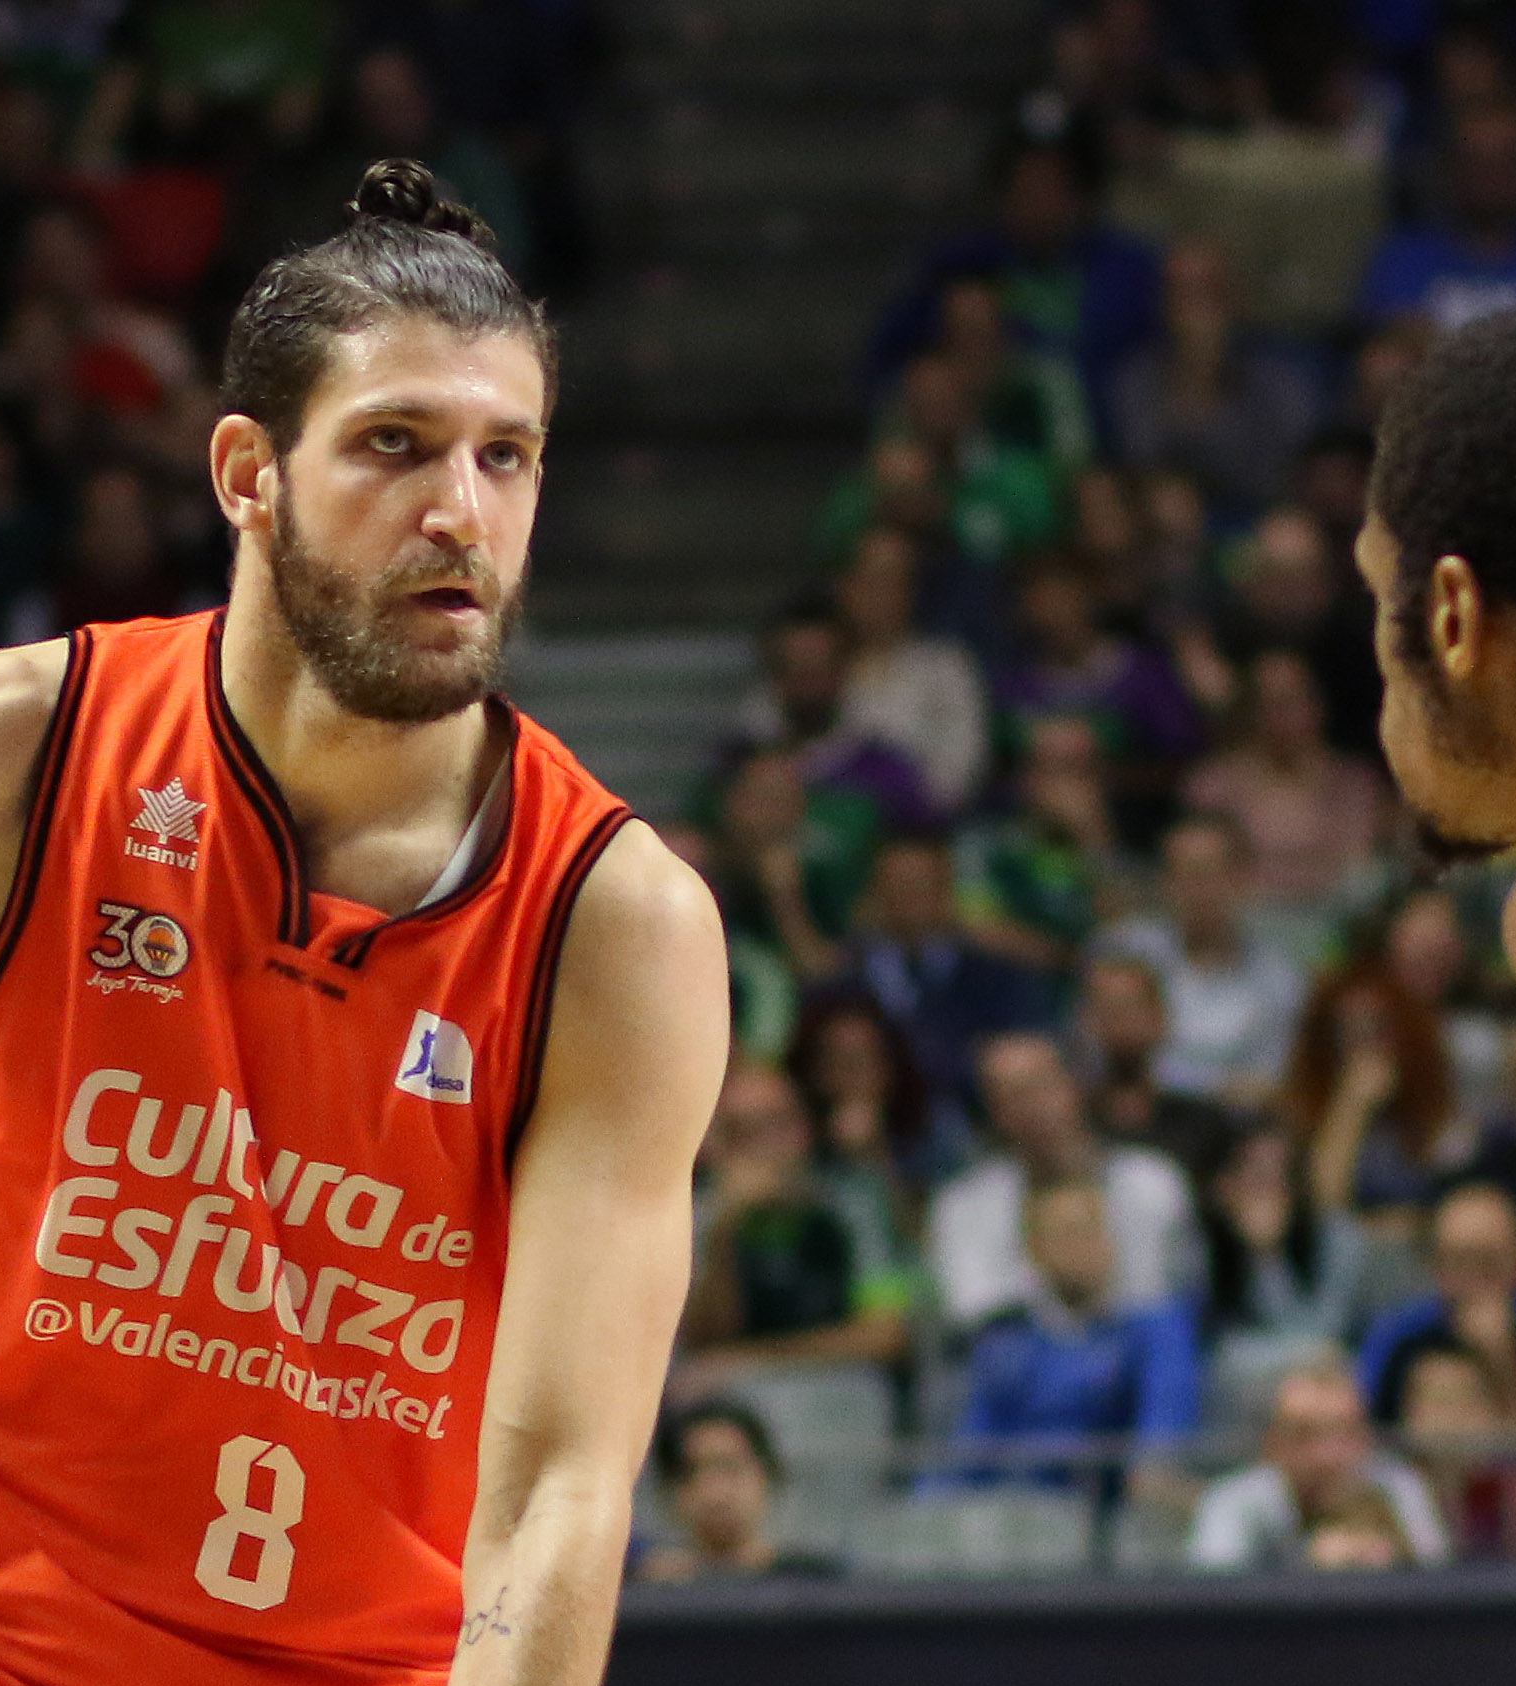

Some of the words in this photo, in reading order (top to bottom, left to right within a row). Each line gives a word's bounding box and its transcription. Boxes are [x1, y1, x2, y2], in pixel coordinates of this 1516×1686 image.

[89, 901, 189, 978] 30
[124, 835, 199, 872] luanvi
[61, 1067, 404, 1249] Cultura
[400, 1213, 475, 1268] de
[35, 1175, 465, 1374] Esfuerzo
[194, 1433, 306, 1612] 8
